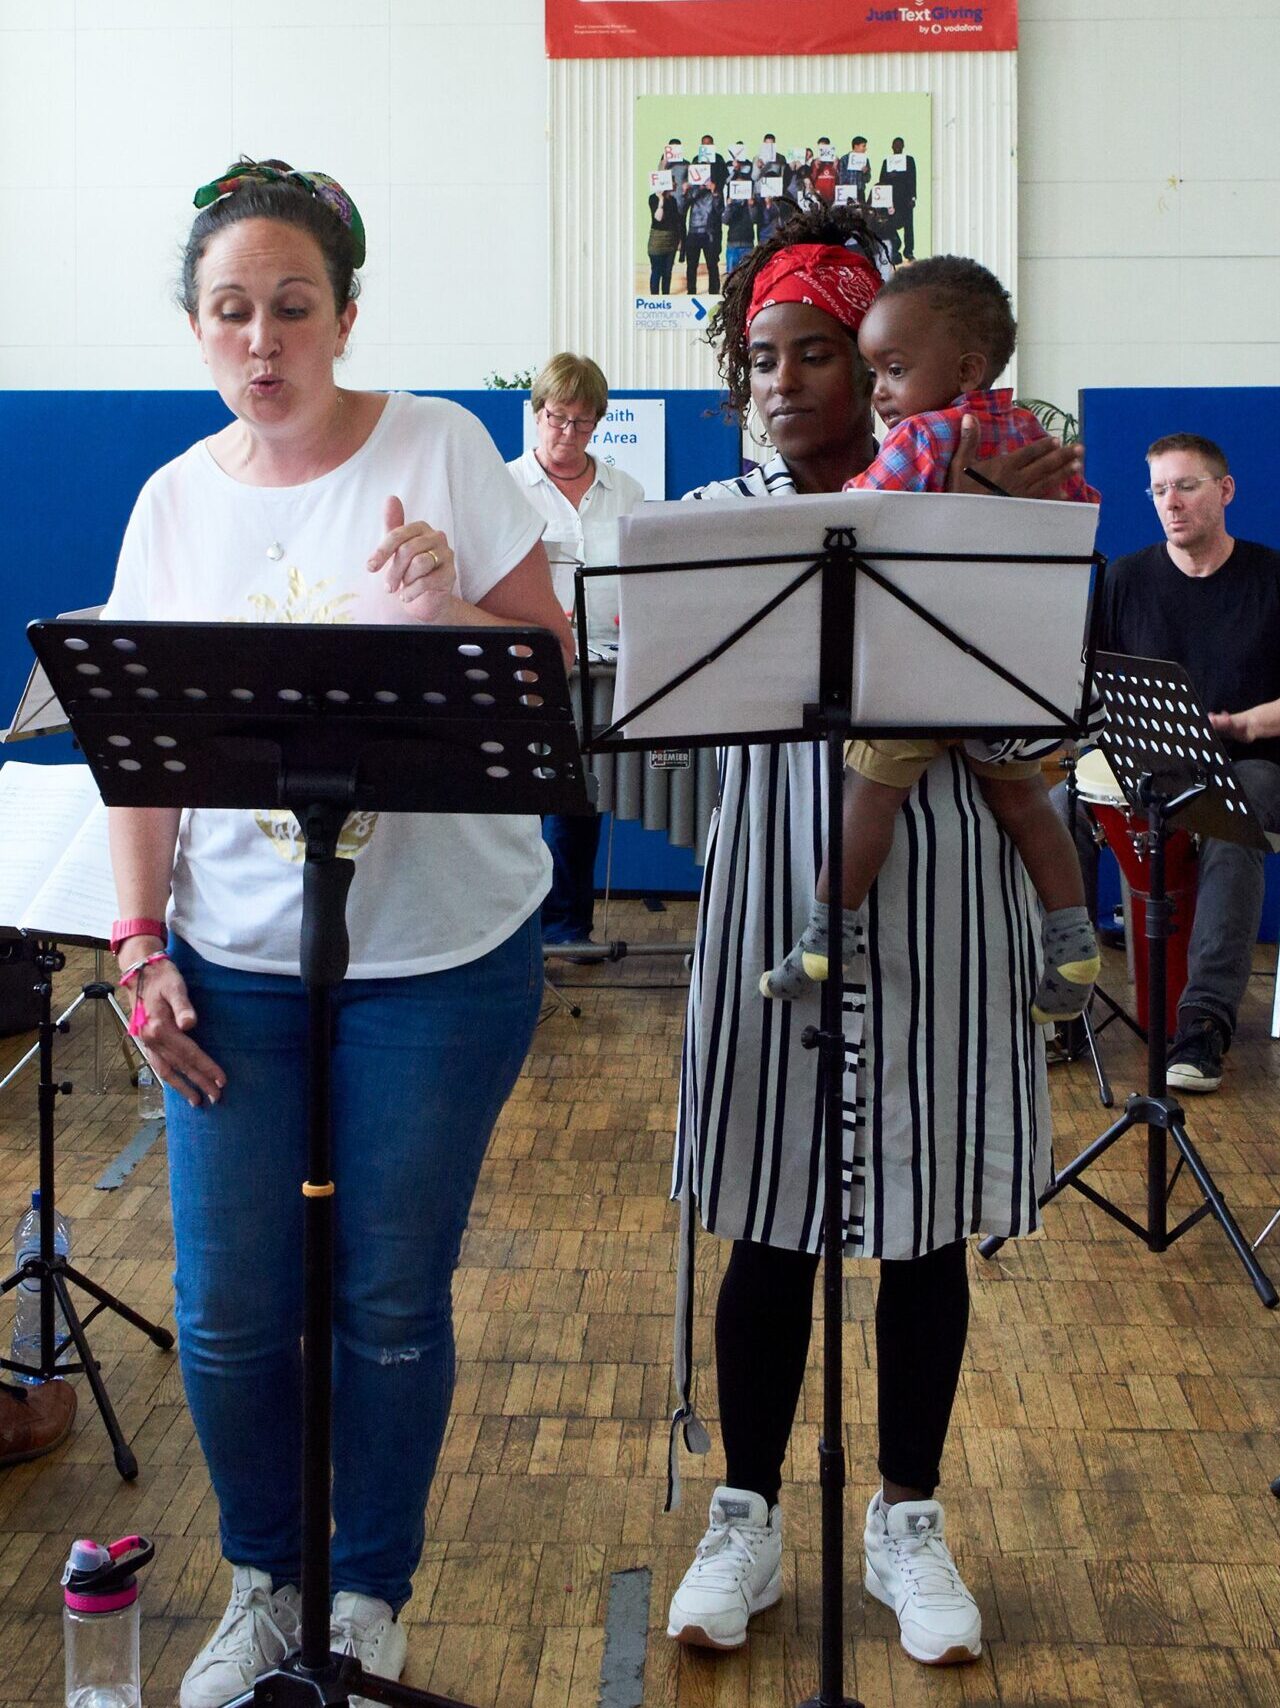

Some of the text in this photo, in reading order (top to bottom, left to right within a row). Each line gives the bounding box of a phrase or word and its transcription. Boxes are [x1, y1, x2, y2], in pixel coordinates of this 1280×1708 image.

[919, 24, 983, 34] by vodafone
[636, 298, 672, 309] Praxis
[636, 311, 692, 319] COMMUNITY
[636, 320, 678, 329] PROJECTS
[605, 409, 634, 422] aith
[603, 431, 638, 444] Area
[652, 753, 688, 761] PREMIER
